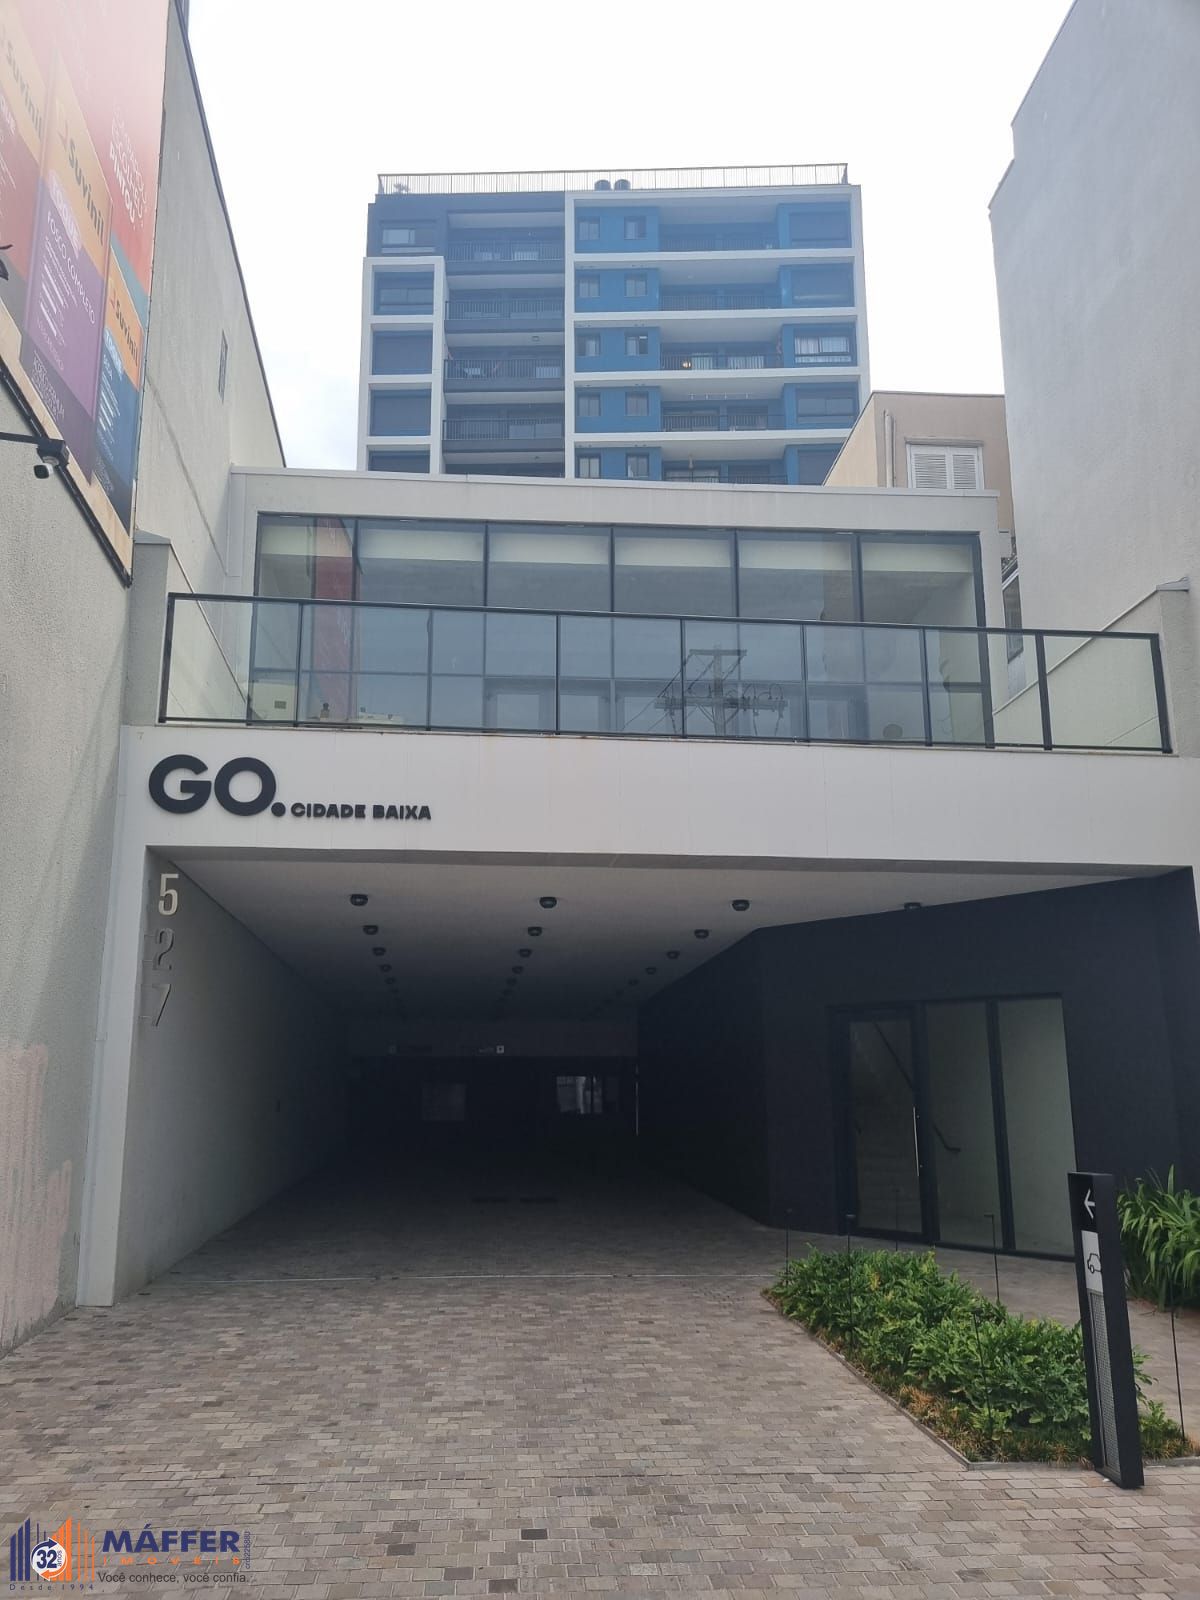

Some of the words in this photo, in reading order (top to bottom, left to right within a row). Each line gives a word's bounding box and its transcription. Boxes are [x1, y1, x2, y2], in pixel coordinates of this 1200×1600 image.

[68, 144, 104, 247] Suvinil
[113, 308, 139, 367] Suvinil
[290, 803, 367, 819] CIDADE
[373, 804, 432, 820] BAIXA
